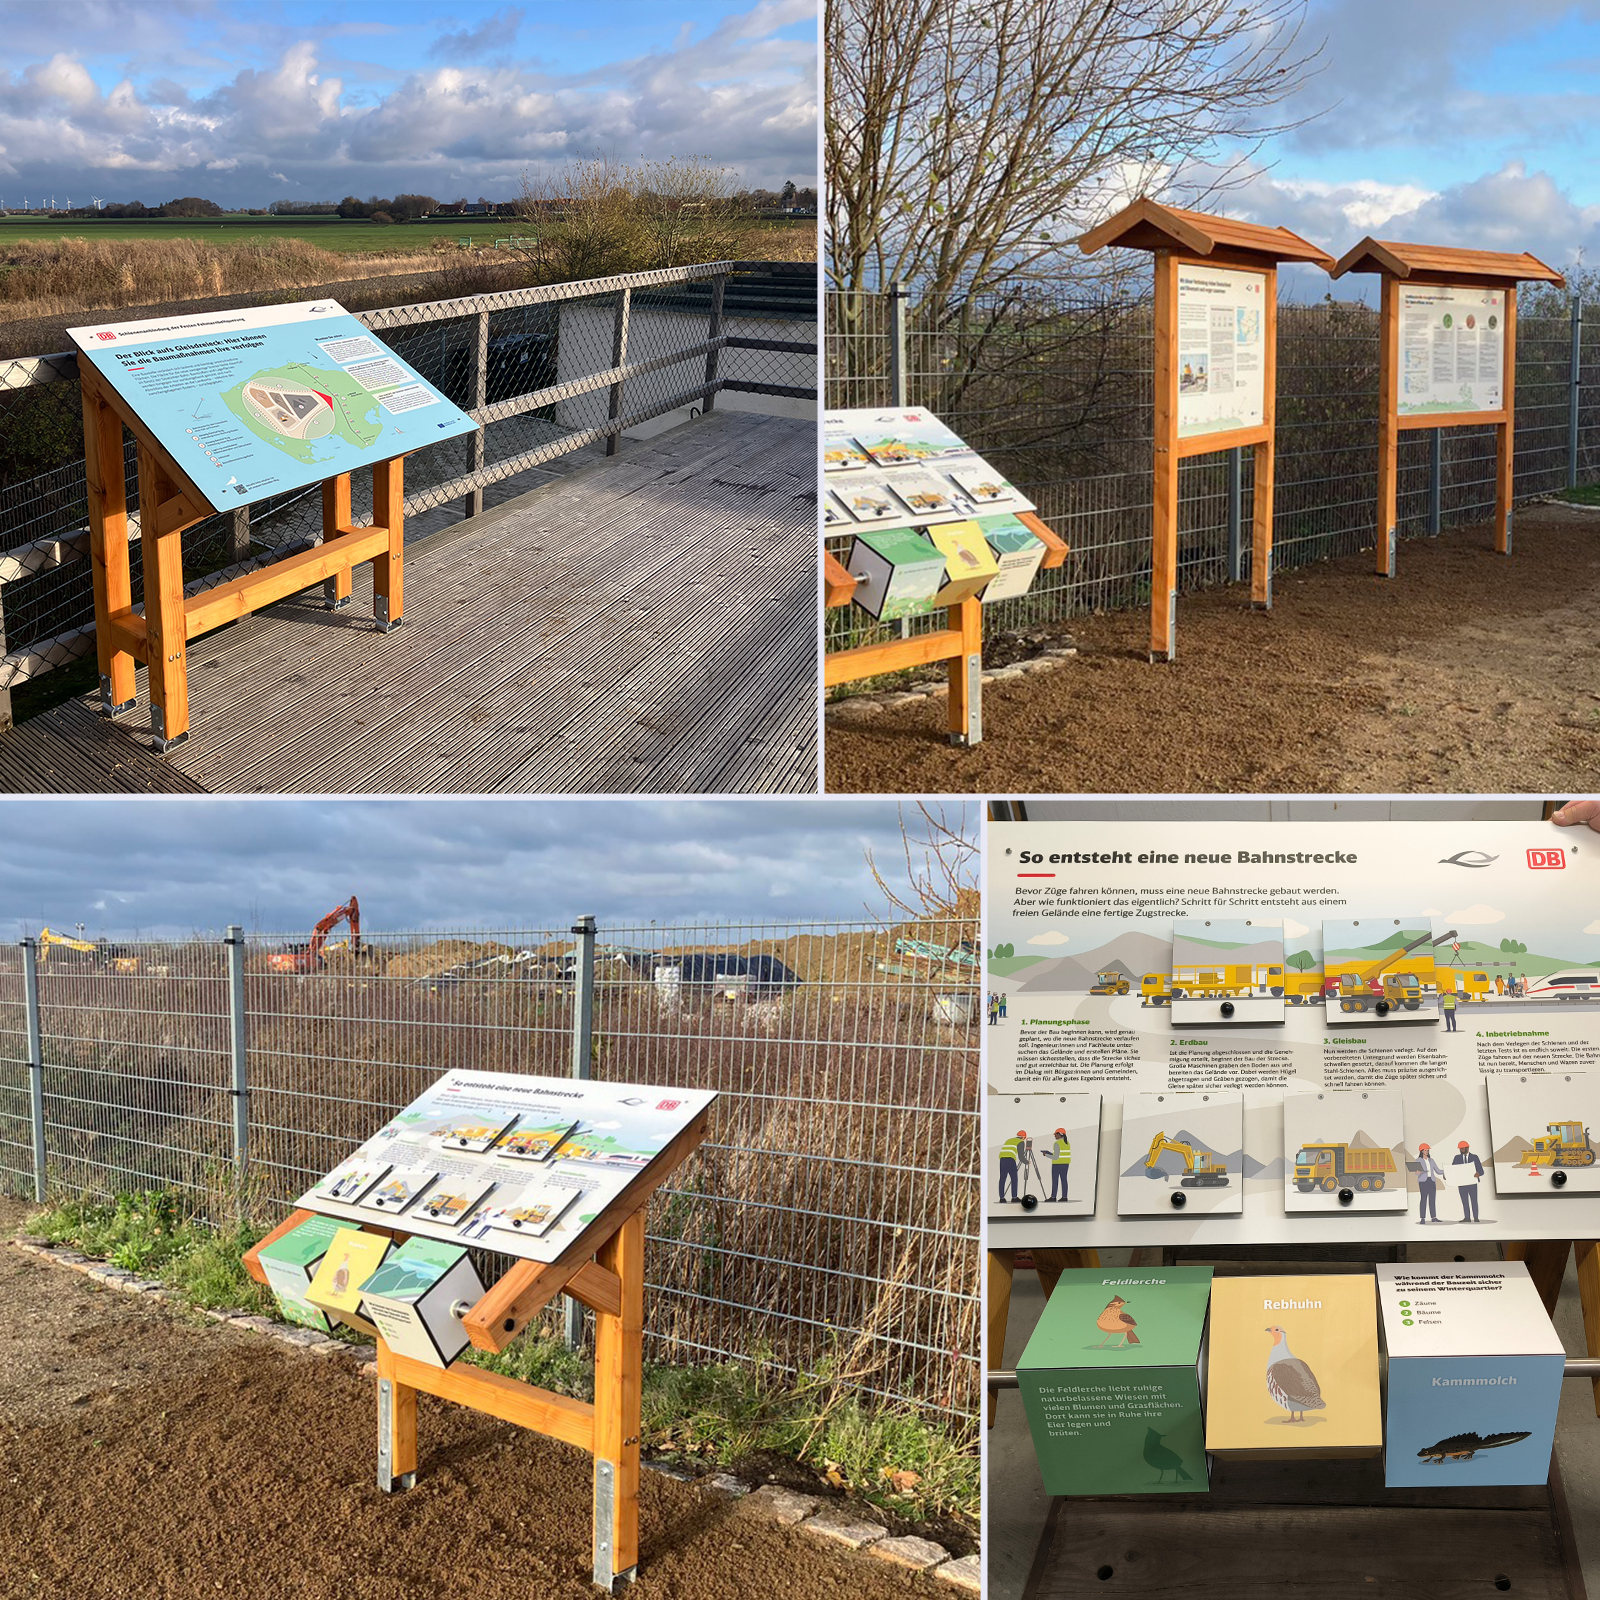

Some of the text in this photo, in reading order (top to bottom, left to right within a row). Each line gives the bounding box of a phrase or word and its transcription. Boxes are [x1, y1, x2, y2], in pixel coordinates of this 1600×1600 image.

[133, 348, 155, 357] Blick
[157, 347, 174, 355] aufs
[175, 340, 224, 351] Gleisdreieck:
[223, 336, 240, 344] Hier
[238, 334, 267, 343] können
[153, 348, 218, 362] Baumaßnahmen
[216, 346, 230, 354] live
[230, 341, 264, 351] verfolgen
[1019, 851, 1358, 864] So entsteht eine neue Bahnstrecke
[1529, 850, 1563, 867] DB
[1044, 887, 1068, 896] Züge
[1269, 888, 1302, 896] gebaut
[1131, 898, 1180, 907] eigentlich?
[1102, 909, 1134, 918] fertige
[1135, 909, 1189, 918] Zugstrecke.
[533, 1088, 584, 1098] Bahnstrecke
[657, 1100, 679, 1110] DB
[1264, 1299, 1322, 1310] Rebhuhn
[1432, 1376, 1516, 1386] Kammmolch
[1128, 1402, 1183, 1410] Grasflächen.
